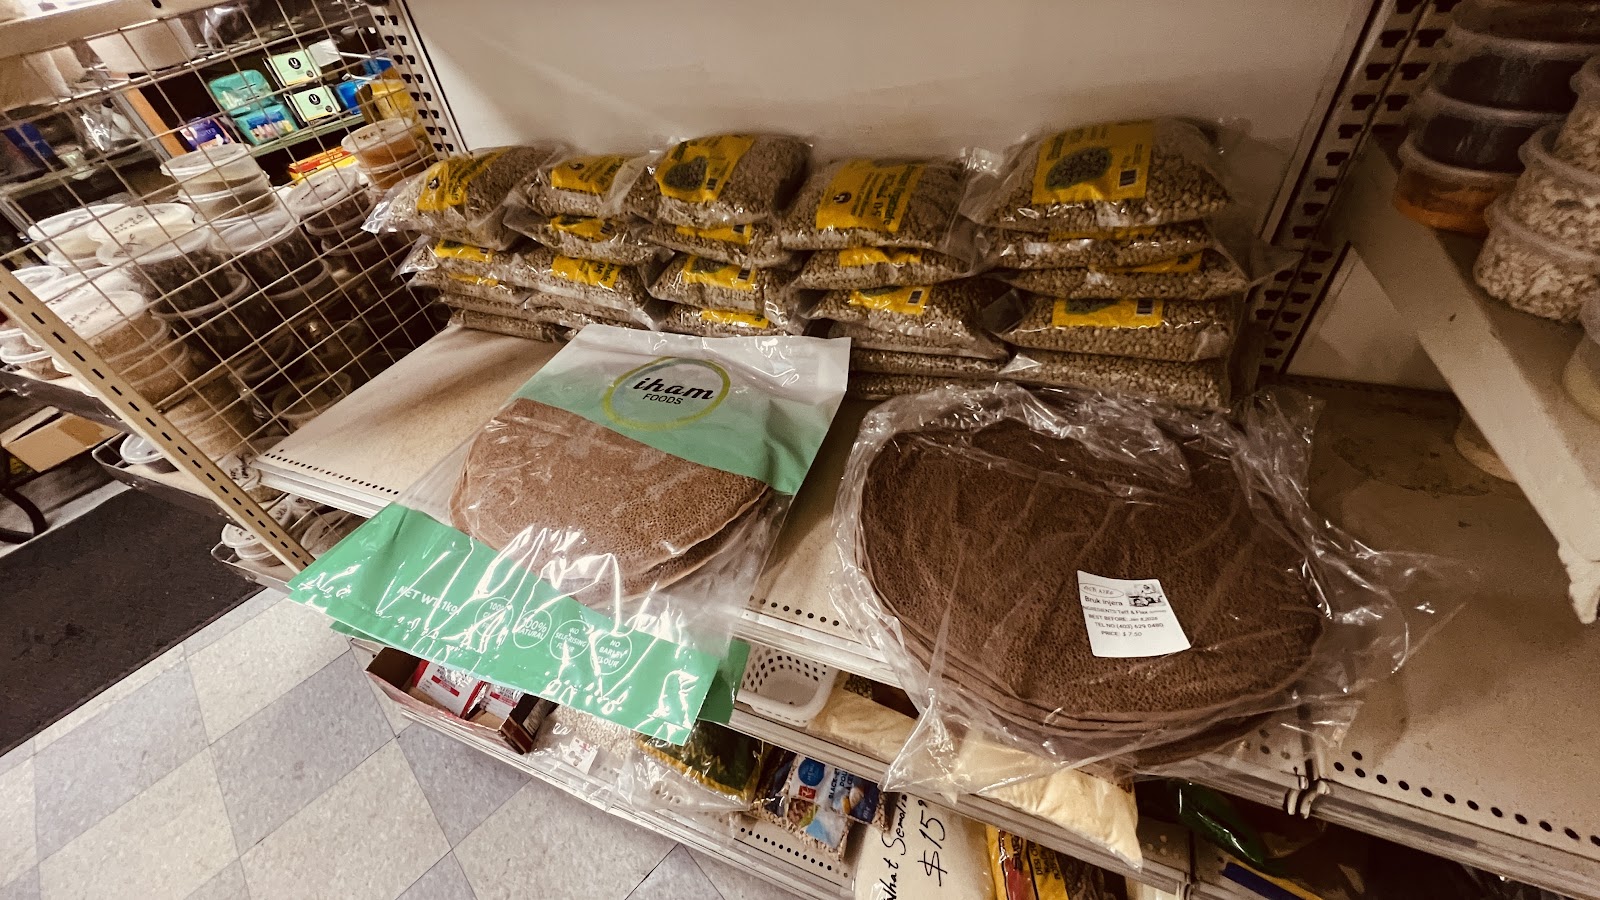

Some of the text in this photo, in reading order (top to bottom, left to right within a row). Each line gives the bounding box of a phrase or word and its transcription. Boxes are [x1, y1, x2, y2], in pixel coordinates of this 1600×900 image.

[633, 377, 714, 400] iham
[642, 394, 684, 405] FOODS
[397, 585, 420, 600] NET
[1084, 596, 1101, 604] Bruk
[522, 616, 548, 634] 100%
[516, 628, 545, 640] ATURAL
[610, 639, 621, 648] NO
[599, 647, 625, 660] BARLEY
